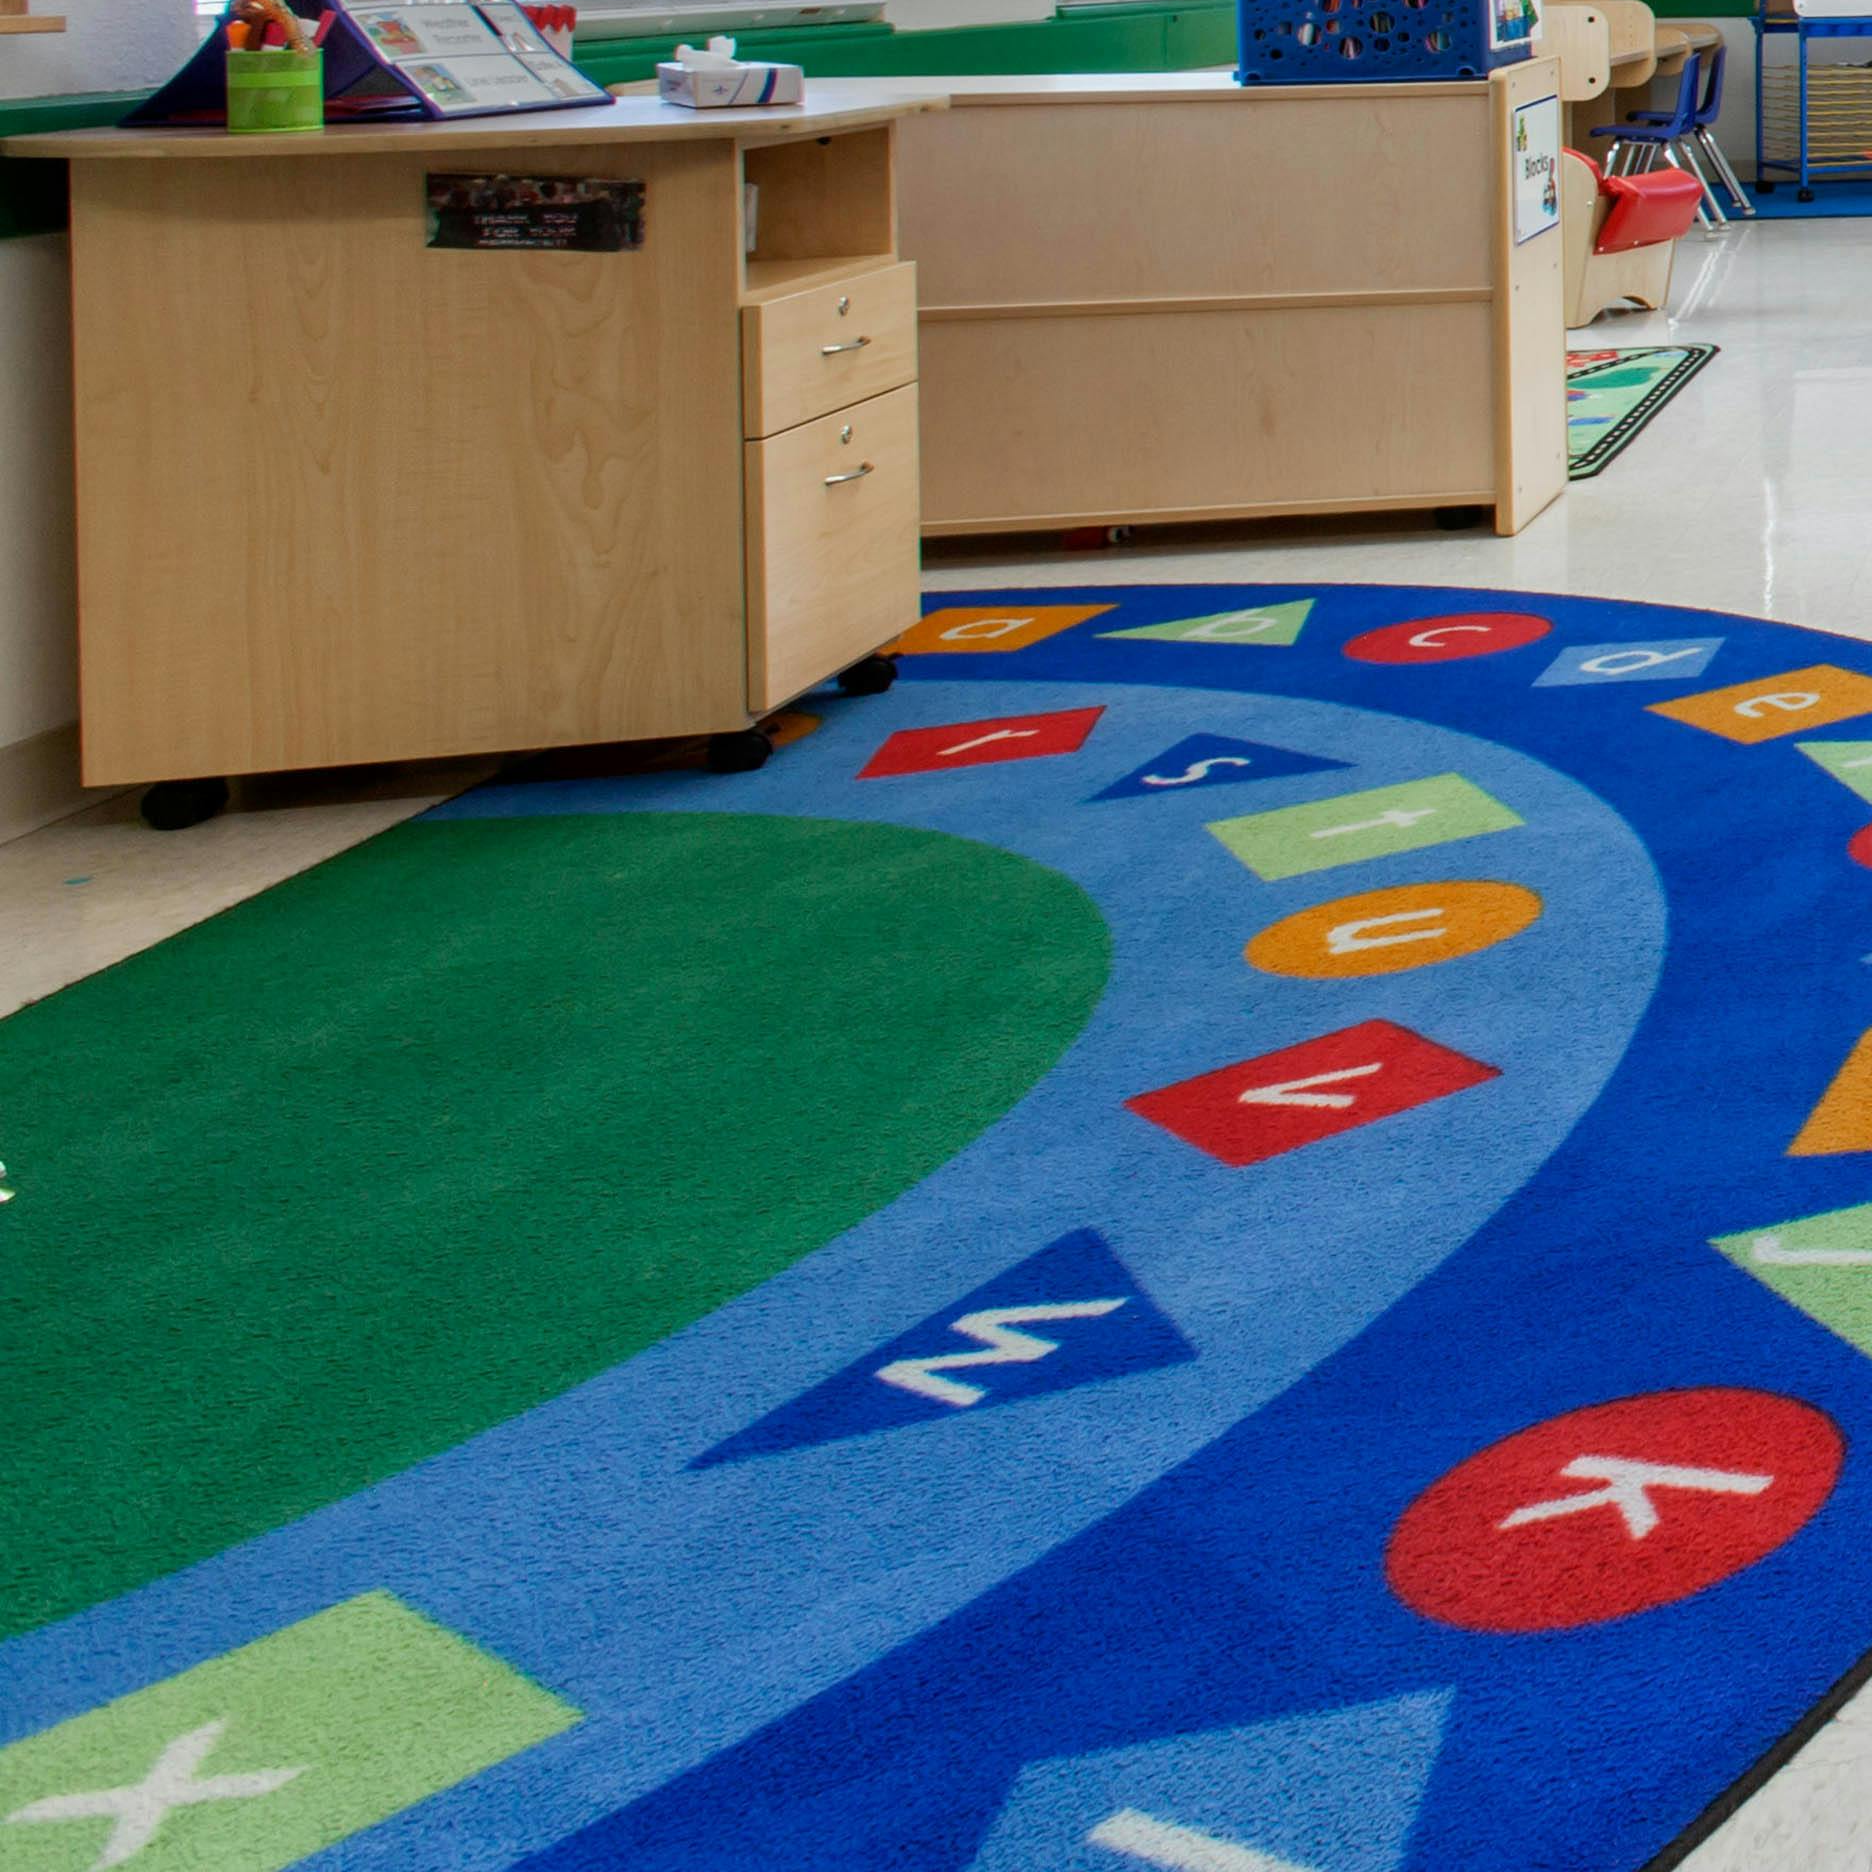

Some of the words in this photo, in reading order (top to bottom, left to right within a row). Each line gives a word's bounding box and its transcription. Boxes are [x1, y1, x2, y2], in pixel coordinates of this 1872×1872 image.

[1525, 154, 1549, 180] Blocks
[938, 617, 1037, 640] a
[1409, 625, 1490, 647] c
[1579, 647, 1702, 676] d
[1733, 691, 1820, 718] e
[936, 729, 1040, 755] r
[1140, 756, 1251, 786] s
[1310, 808, 1436, 838] t
[1326, 907, 1447, 955] u
